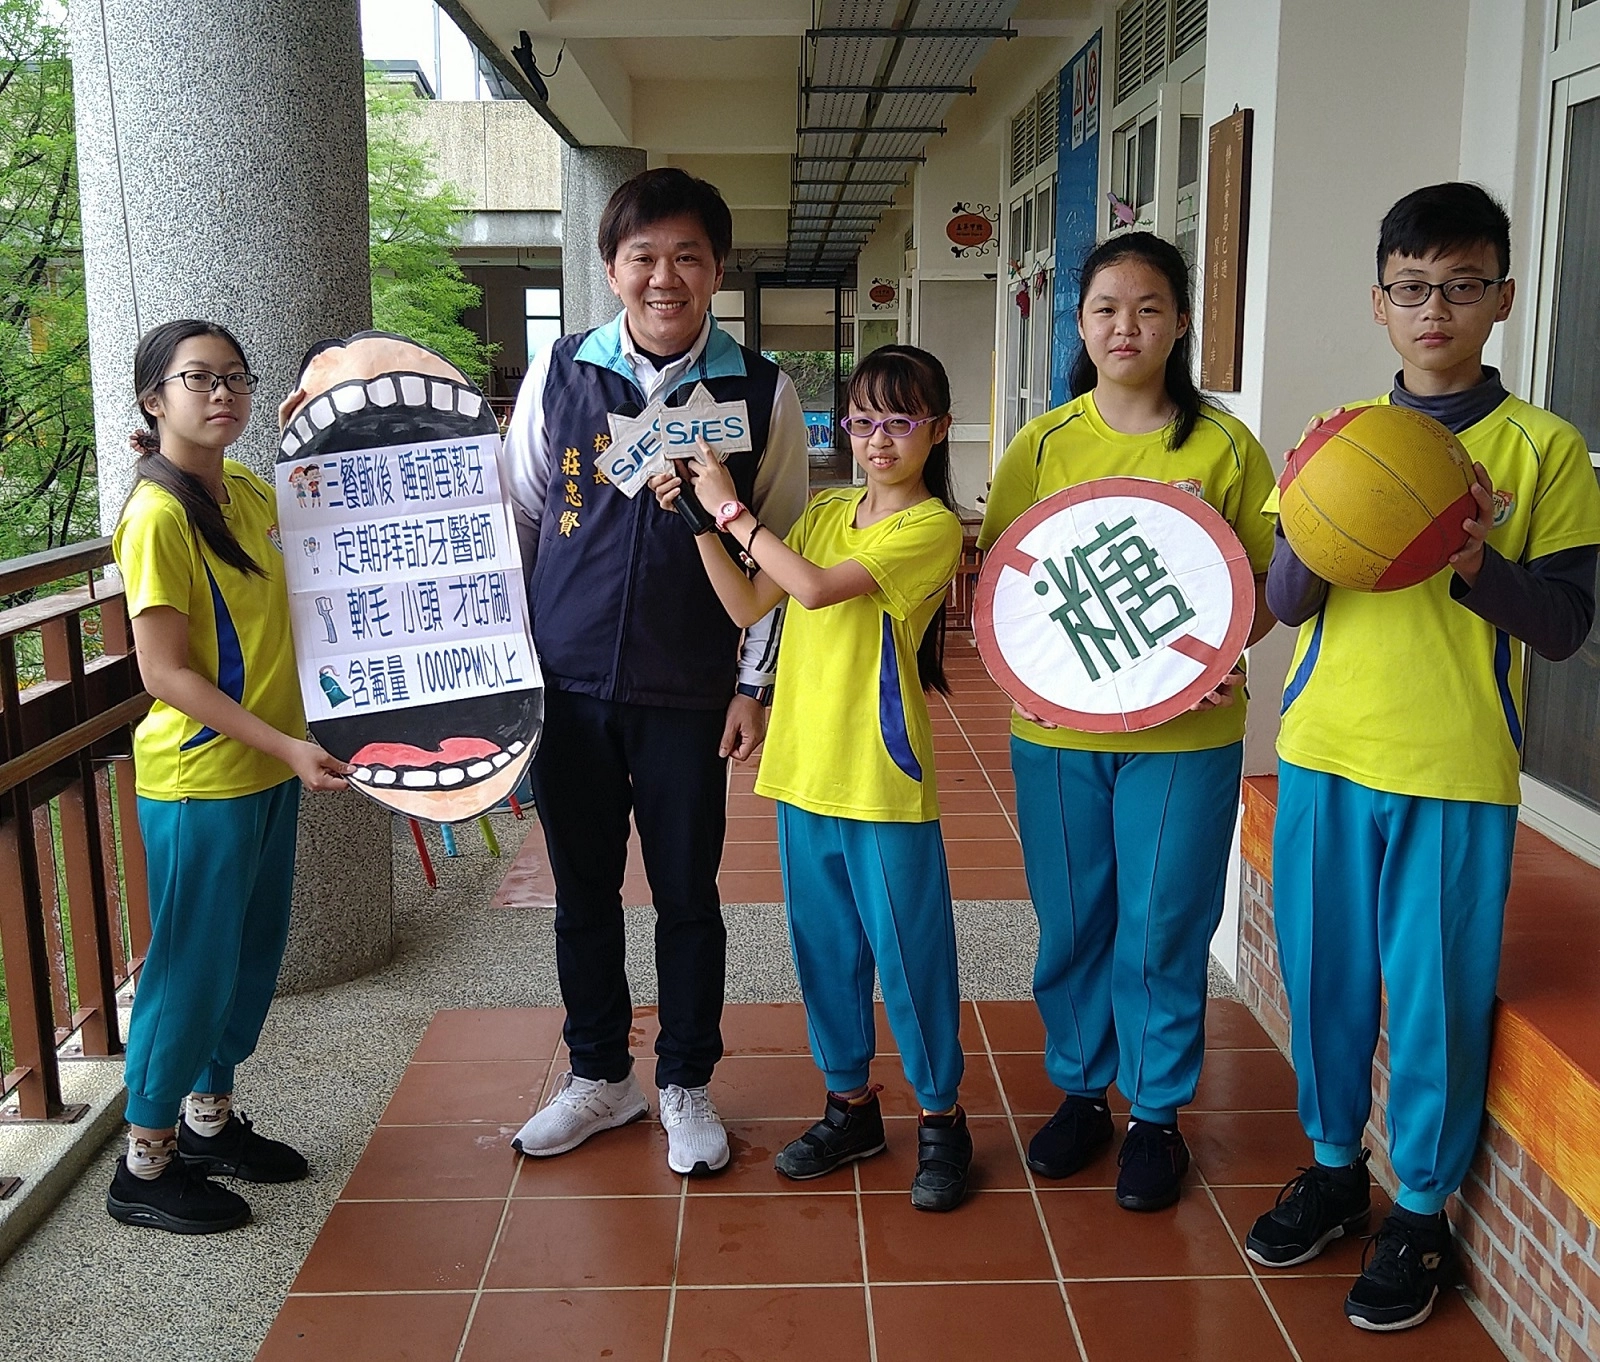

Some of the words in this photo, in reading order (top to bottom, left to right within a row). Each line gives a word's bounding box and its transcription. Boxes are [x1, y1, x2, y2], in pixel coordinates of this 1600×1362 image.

[324, 454, 395, 509] 三餐飯後
[398, 445, 484, 501] 睡前要潔牙
[559, 447, 583, 538] 莊忠賢
[333, 513, 496, 576] 定期拜訪牙醫師
[347, 586, 393, 640] 軟毛
[401, 581, 444, 633] 小頭
[449, 572, 512, 627] 才好刷
[1034, 516, 1197, 682] 糖
[348, 654, 410, 708] 含氟量
[417, 641, 523, 693] 1000PPM以上
